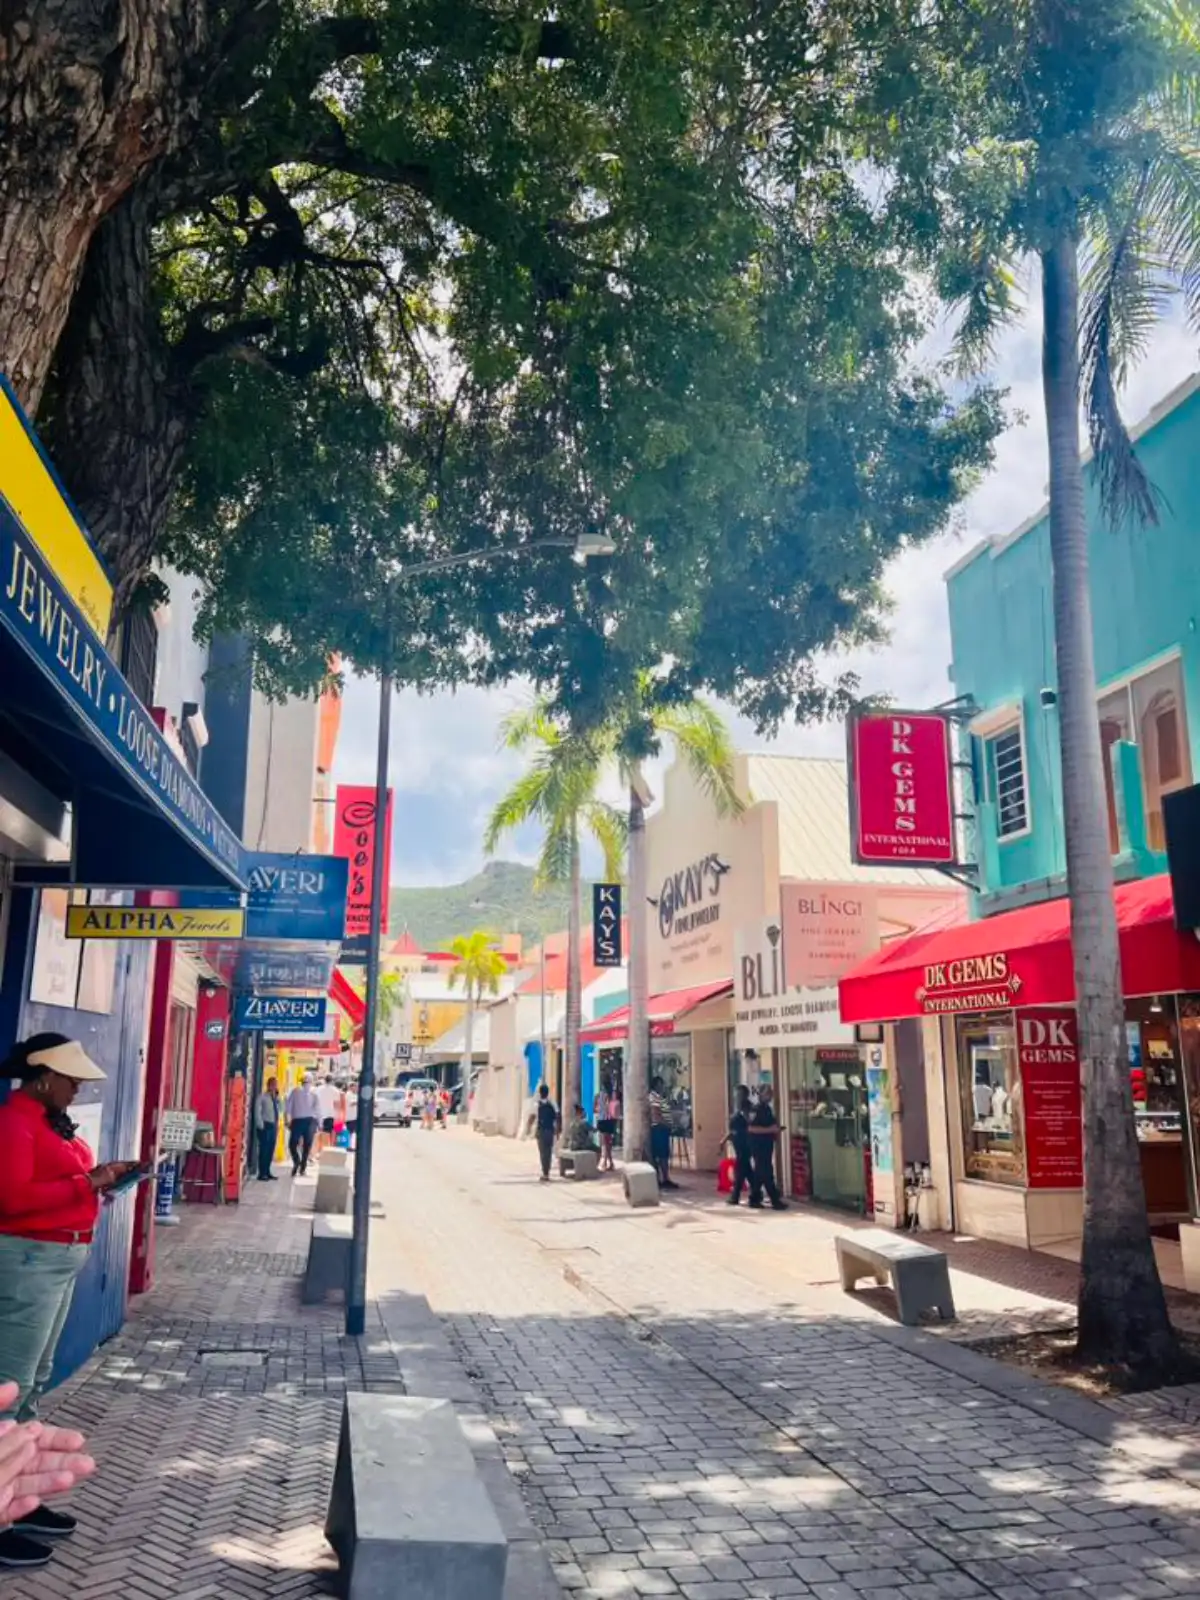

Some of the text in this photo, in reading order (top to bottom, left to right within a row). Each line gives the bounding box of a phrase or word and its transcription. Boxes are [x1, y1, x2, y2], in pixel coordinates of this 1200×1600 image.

[6, 541, 106, 709] JEWELRY
[118, 695, 160, 780] LOOSE
[892, 720, 914, 754] DK
[891, 760, 917, 831] GEMS
[864, 833, 949, 847] INTERNATIONAL
[247, 866, 325, 895] AVERI
[83, 909, 175, 931] ALPHA
[598, 887, 617, 956] KAY'S
[924, 953, 1007, 988] DK GEMS
[245, 997, 319, 1018] ZHAVERI
[924, 991, 1010, 1012] INTERNATIONAL
[1020, 1019, 1074, 1046] DK
[1021, 1050, 1076, 1063] GEMS
